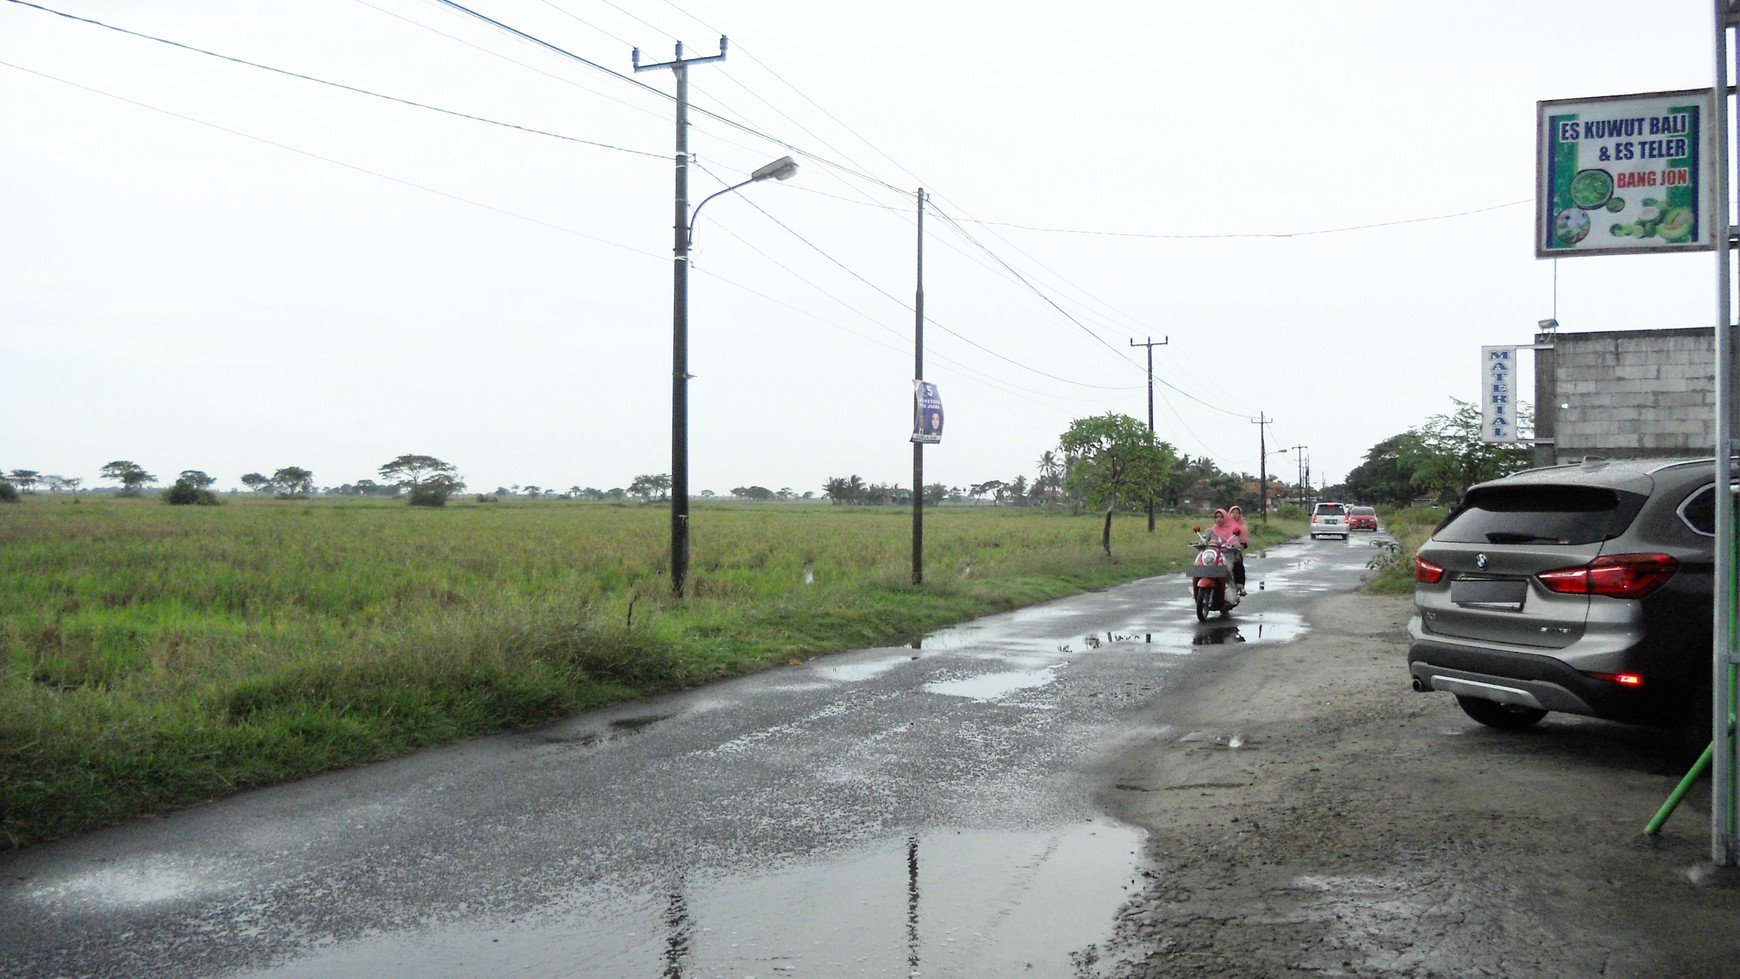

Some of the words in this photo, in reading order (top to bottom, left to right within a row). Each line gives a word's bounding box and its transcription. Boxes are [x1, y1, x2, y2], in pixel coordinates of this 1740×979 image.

[1560, 122, 1580, 141] ES
[1584, 117, 1646, 140] KUWUT
[1649, 115, 1687, 135] BALI
[1598, 146, 1611, 162] &
[1615, 142, 1634, 161] ES
[1638, 139, 1686, 160] TELER
[1617, 171, 1656, 189] BANG
[1660, 169, 1687, 187] JON
[926, 385, 933, 396] 5
[1489, 351, 1509, 437] MATERIAL
